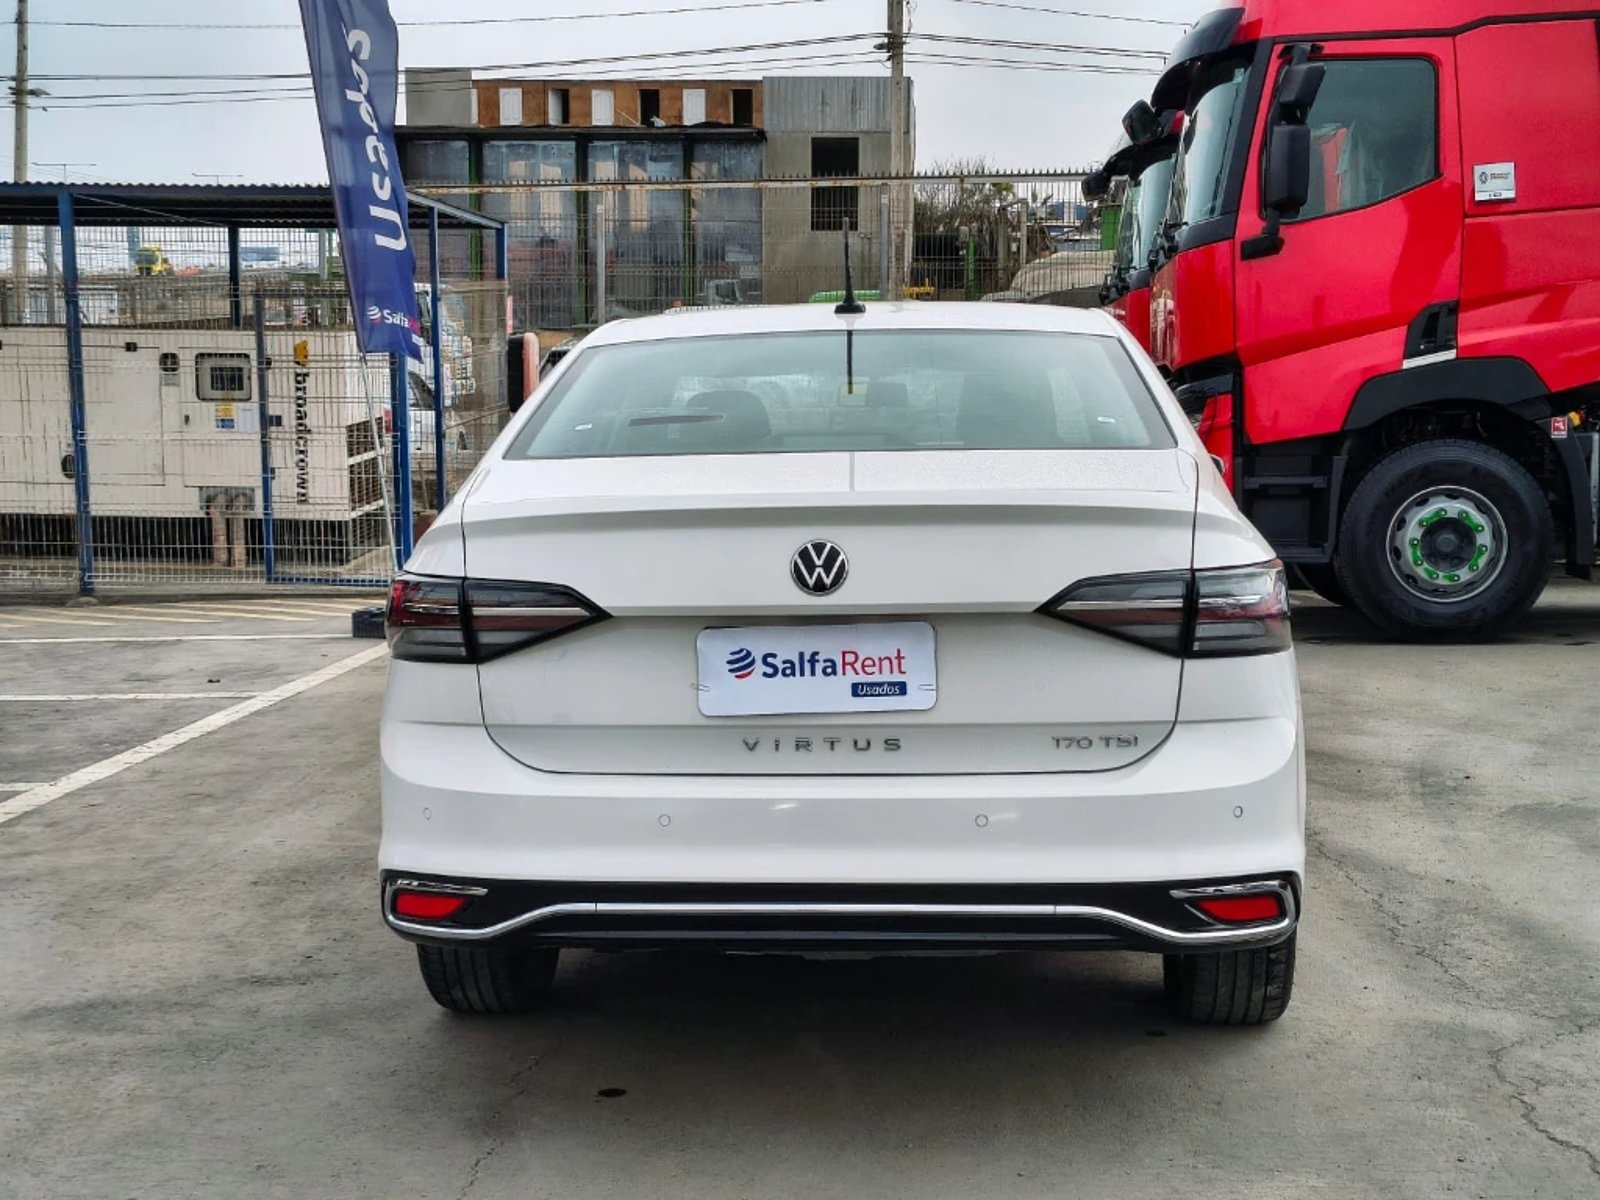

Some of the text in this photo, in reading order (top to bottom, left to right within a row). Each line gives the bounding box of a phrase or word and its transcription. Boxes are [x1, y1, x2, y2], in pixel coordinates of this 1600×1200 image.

[294, 370, 312, 506] broadcrown
[761, 648, 907, 679] SalfaRent
[857, 683, 900, 696] Usados
[742, 737, 902, 752] VIRTUS
[1051, 735, 1138, 749] 170 TSI
